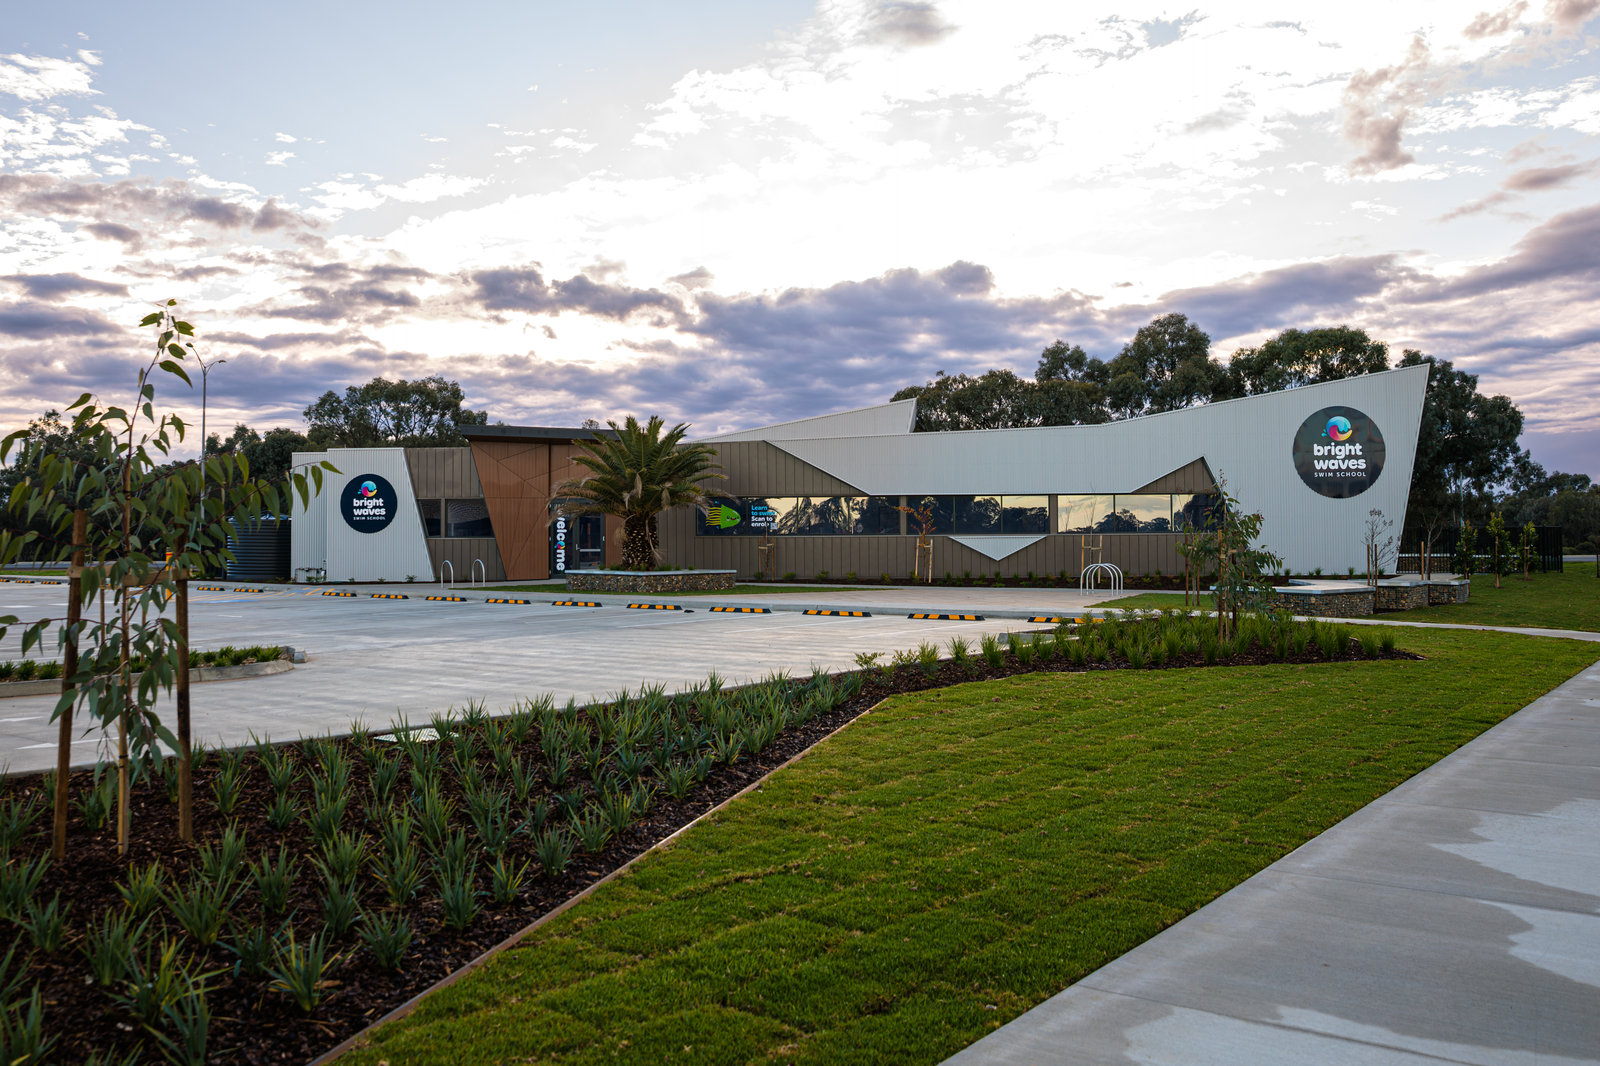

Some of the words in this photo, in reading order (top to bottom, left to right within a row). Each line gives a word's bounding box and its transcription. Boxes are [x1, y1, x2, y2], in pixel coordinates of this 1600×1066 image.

[1313, 442, 1362, 459] bright
[1313, 459, 1366, 470] waves
[353, 497, 384, 509] bright
